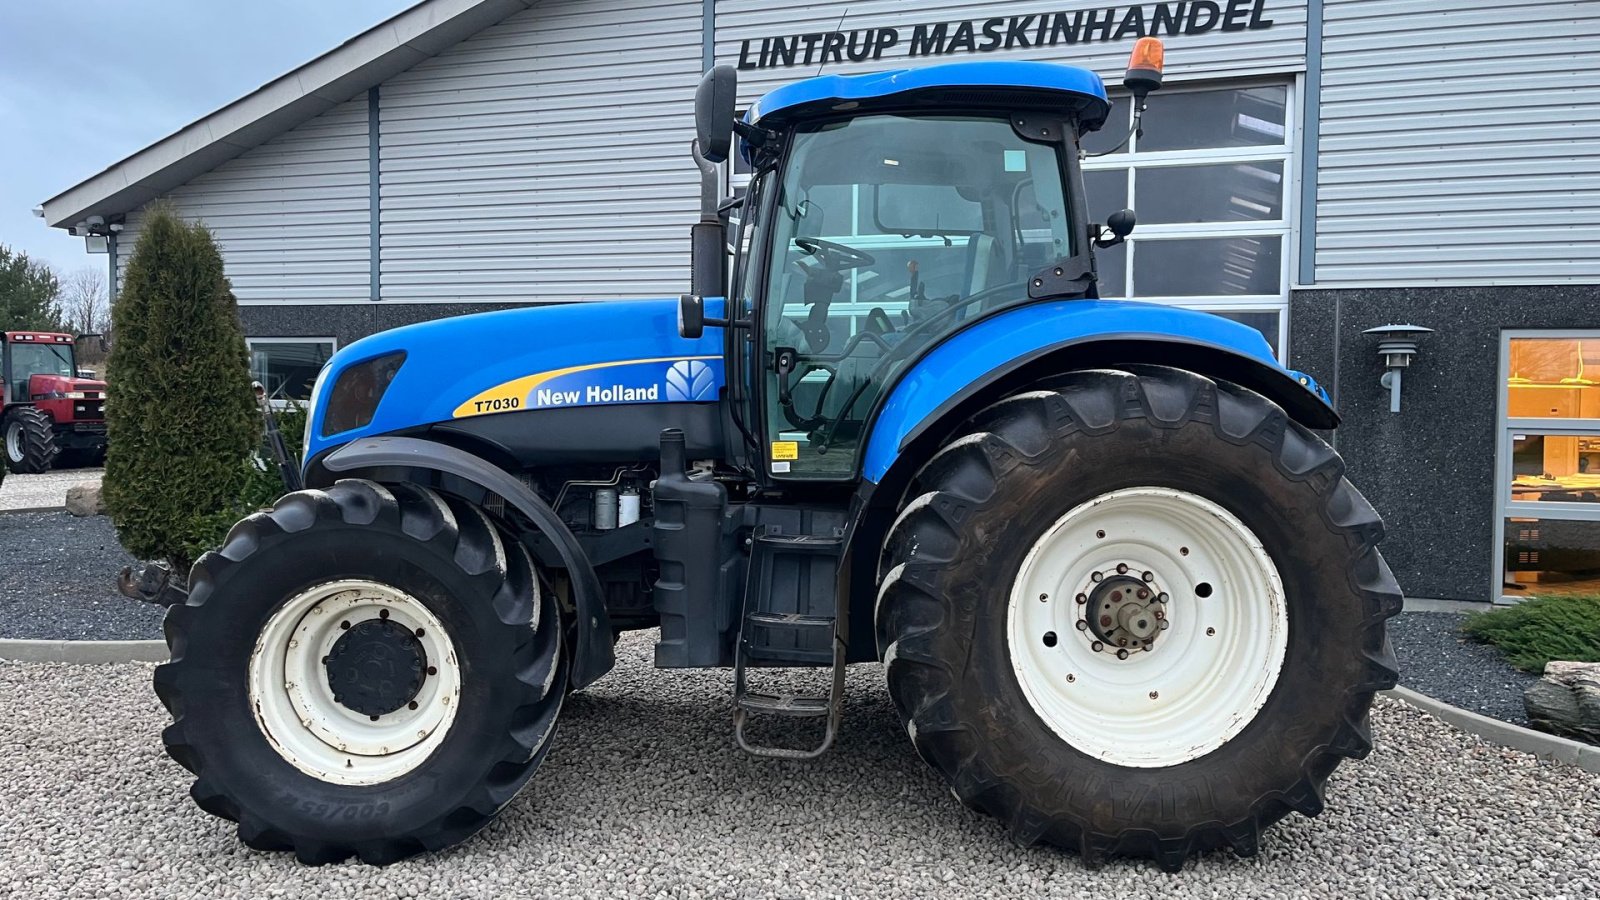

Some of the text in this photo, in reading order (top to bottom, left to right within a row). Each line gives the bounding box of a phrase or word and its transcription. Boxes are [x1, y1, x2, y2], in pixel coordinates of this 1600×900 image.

[738, 0, 1274, 70] LINTRUP MASKINHANDEL
[474, 397, 519, 413] T7030
[537, 384, 658, 406] New Holland
